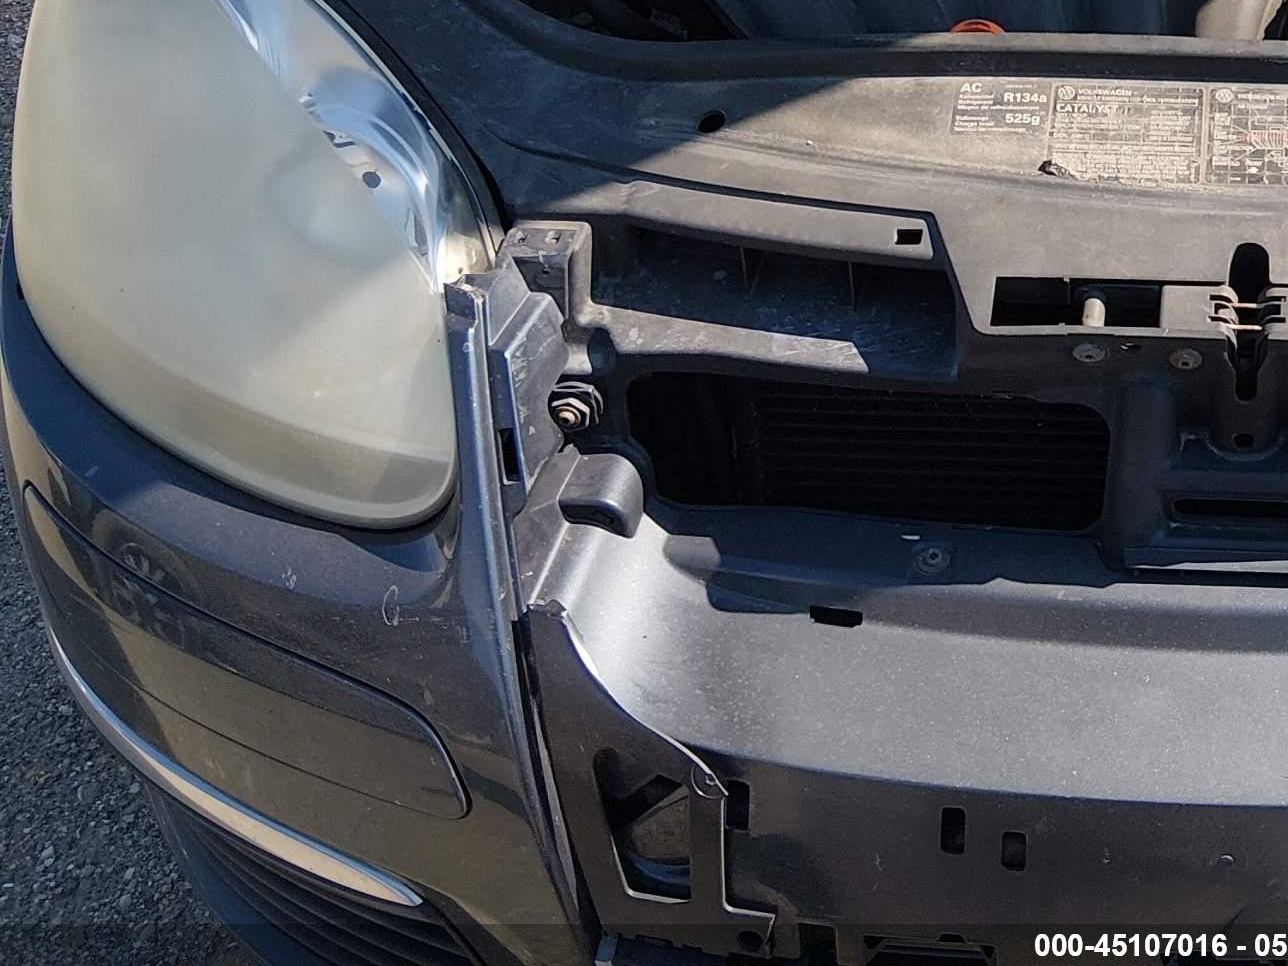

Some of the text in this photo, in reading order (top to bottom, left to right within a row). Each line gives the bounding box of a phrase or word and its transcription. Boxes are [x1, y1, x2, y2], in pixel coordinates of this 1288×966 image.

[960, 82, 982, 93] AC
[1003, 92, 1047, 103] R134a
[1056, 104, 1119, 114] CATALYST
[1005, 113, 1040, 126] 525g
